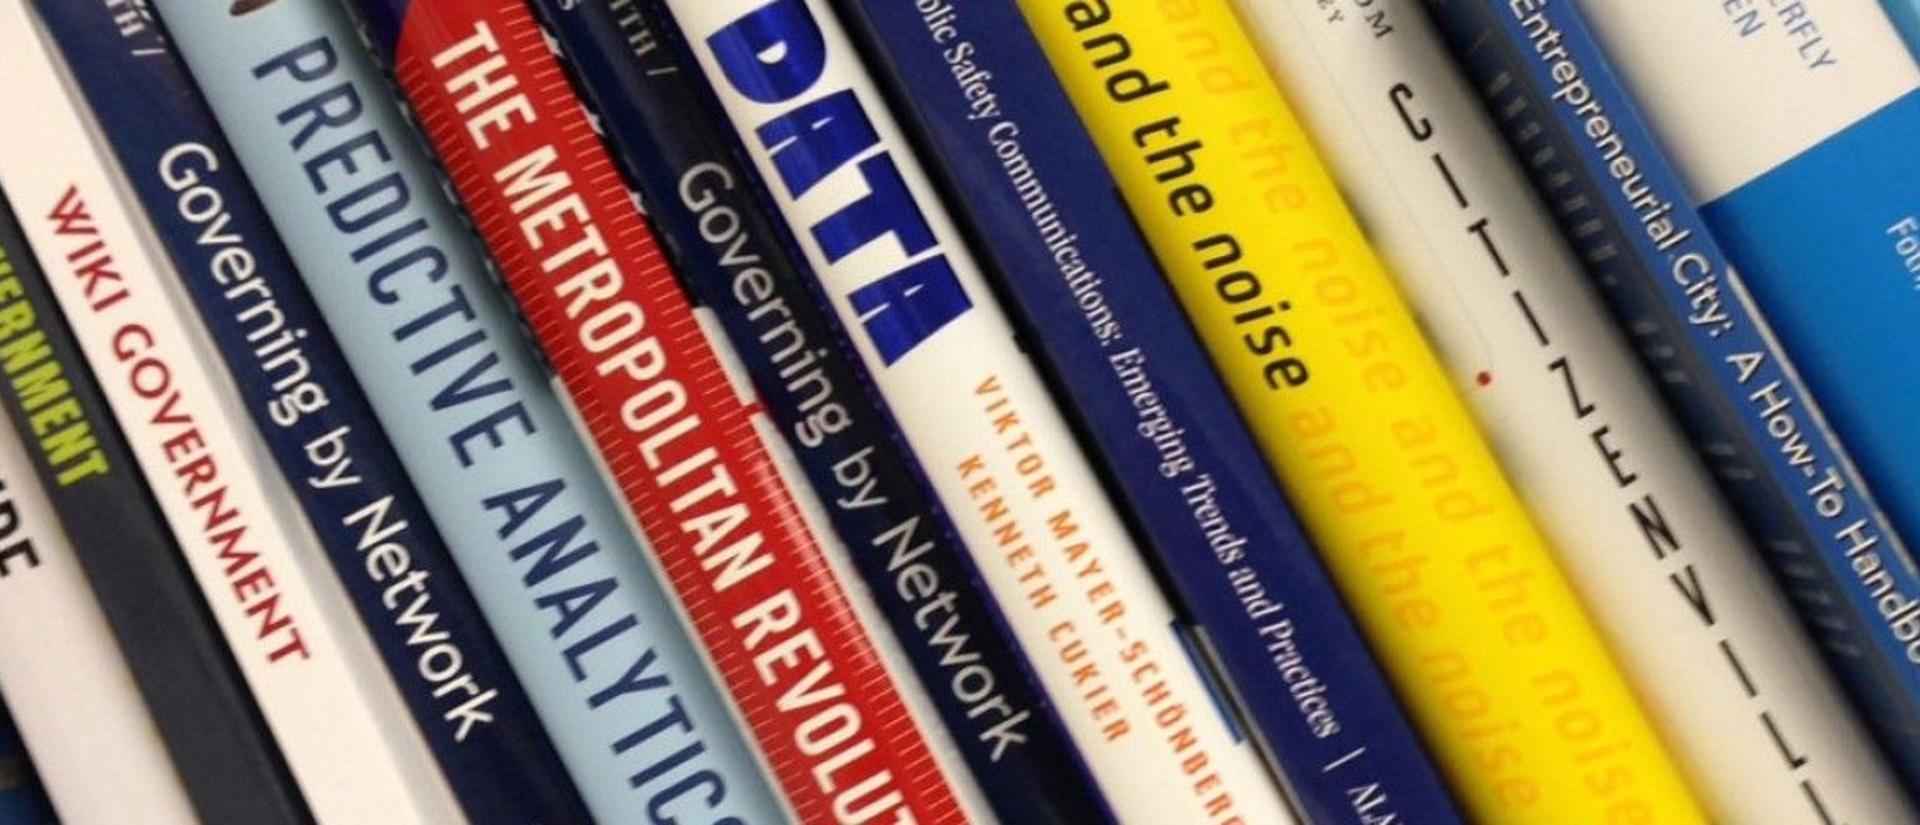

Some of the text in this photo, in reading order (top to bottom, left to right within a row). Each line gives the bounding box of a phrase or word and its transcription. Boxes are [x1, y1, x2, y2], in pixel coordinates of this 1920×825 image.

[47, 184, 311, 664] WIKI GOVERNMENT
[431, 20, 537, 150] THE
[493, 144, 775, 592] METROPOLITAN
[706, 0, 974, 368] DATA
[943, 41, 1000, 120] Safety
[987, 121, 1123, 347] Communications:
[1109, 347, 1195, 478] Emerging
[1180, 473, 1247, 565] Trends
[1228, 565, 1284, 620] and
[1258, 618, 1342, 738] Practices
[1064, 0, 1171, 103] and
[1132, 116, 1215, 218] the
[1193, 233, 1308, 390] noise
[1672, 253, 1735, 338] City:
[1726, 351, 1765, 384] A
[1751, 382, 1845, 518] How-To
[159, 141, 498, 743] Governing by Network
[251, 36, 750, 825] PREDICTIVE ANALYTIC
[678, 161, 1031, 763] Governing by Network
[955, 453, 1132, 743] KENNETH CUKIER
[974, 375, 1057, 498] VIKTOR
